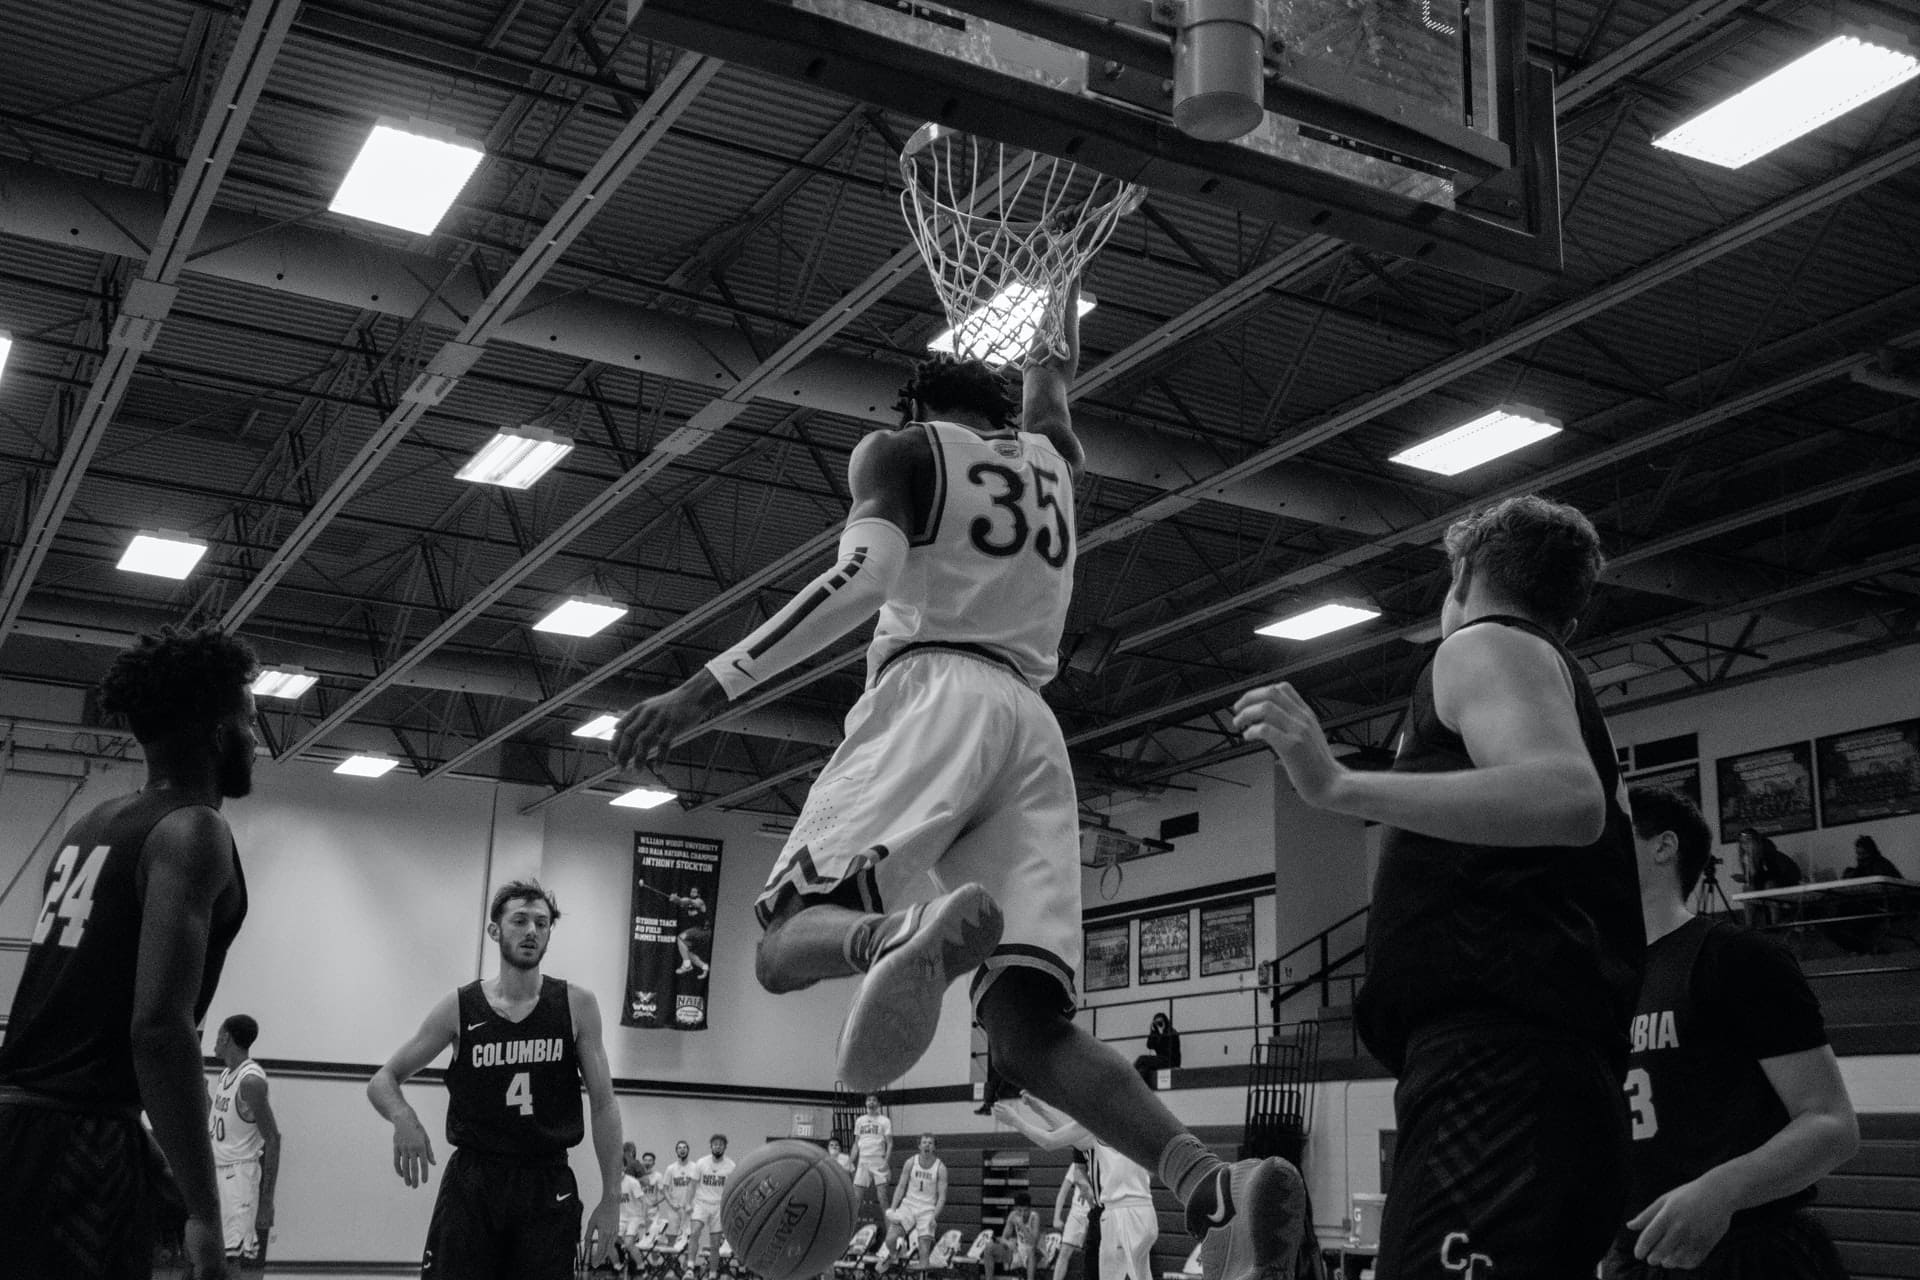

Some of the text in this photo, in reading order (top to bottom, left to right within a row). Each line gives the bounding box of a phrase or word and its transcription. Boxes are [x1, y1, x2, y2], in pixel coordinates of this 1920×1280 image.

[968, 461, 1070, 571] 35
[642, 856, 713, 872] ANTHONY STOCKTON
[31, 845, 111, 948] 24
[645, 926, 661, 934] FIELD
[472, 1038, 563, 1068] COLUMBIA
[1630, 1011, 1679, 1053] BIA
[506, 1071, 533, 1115] 4
